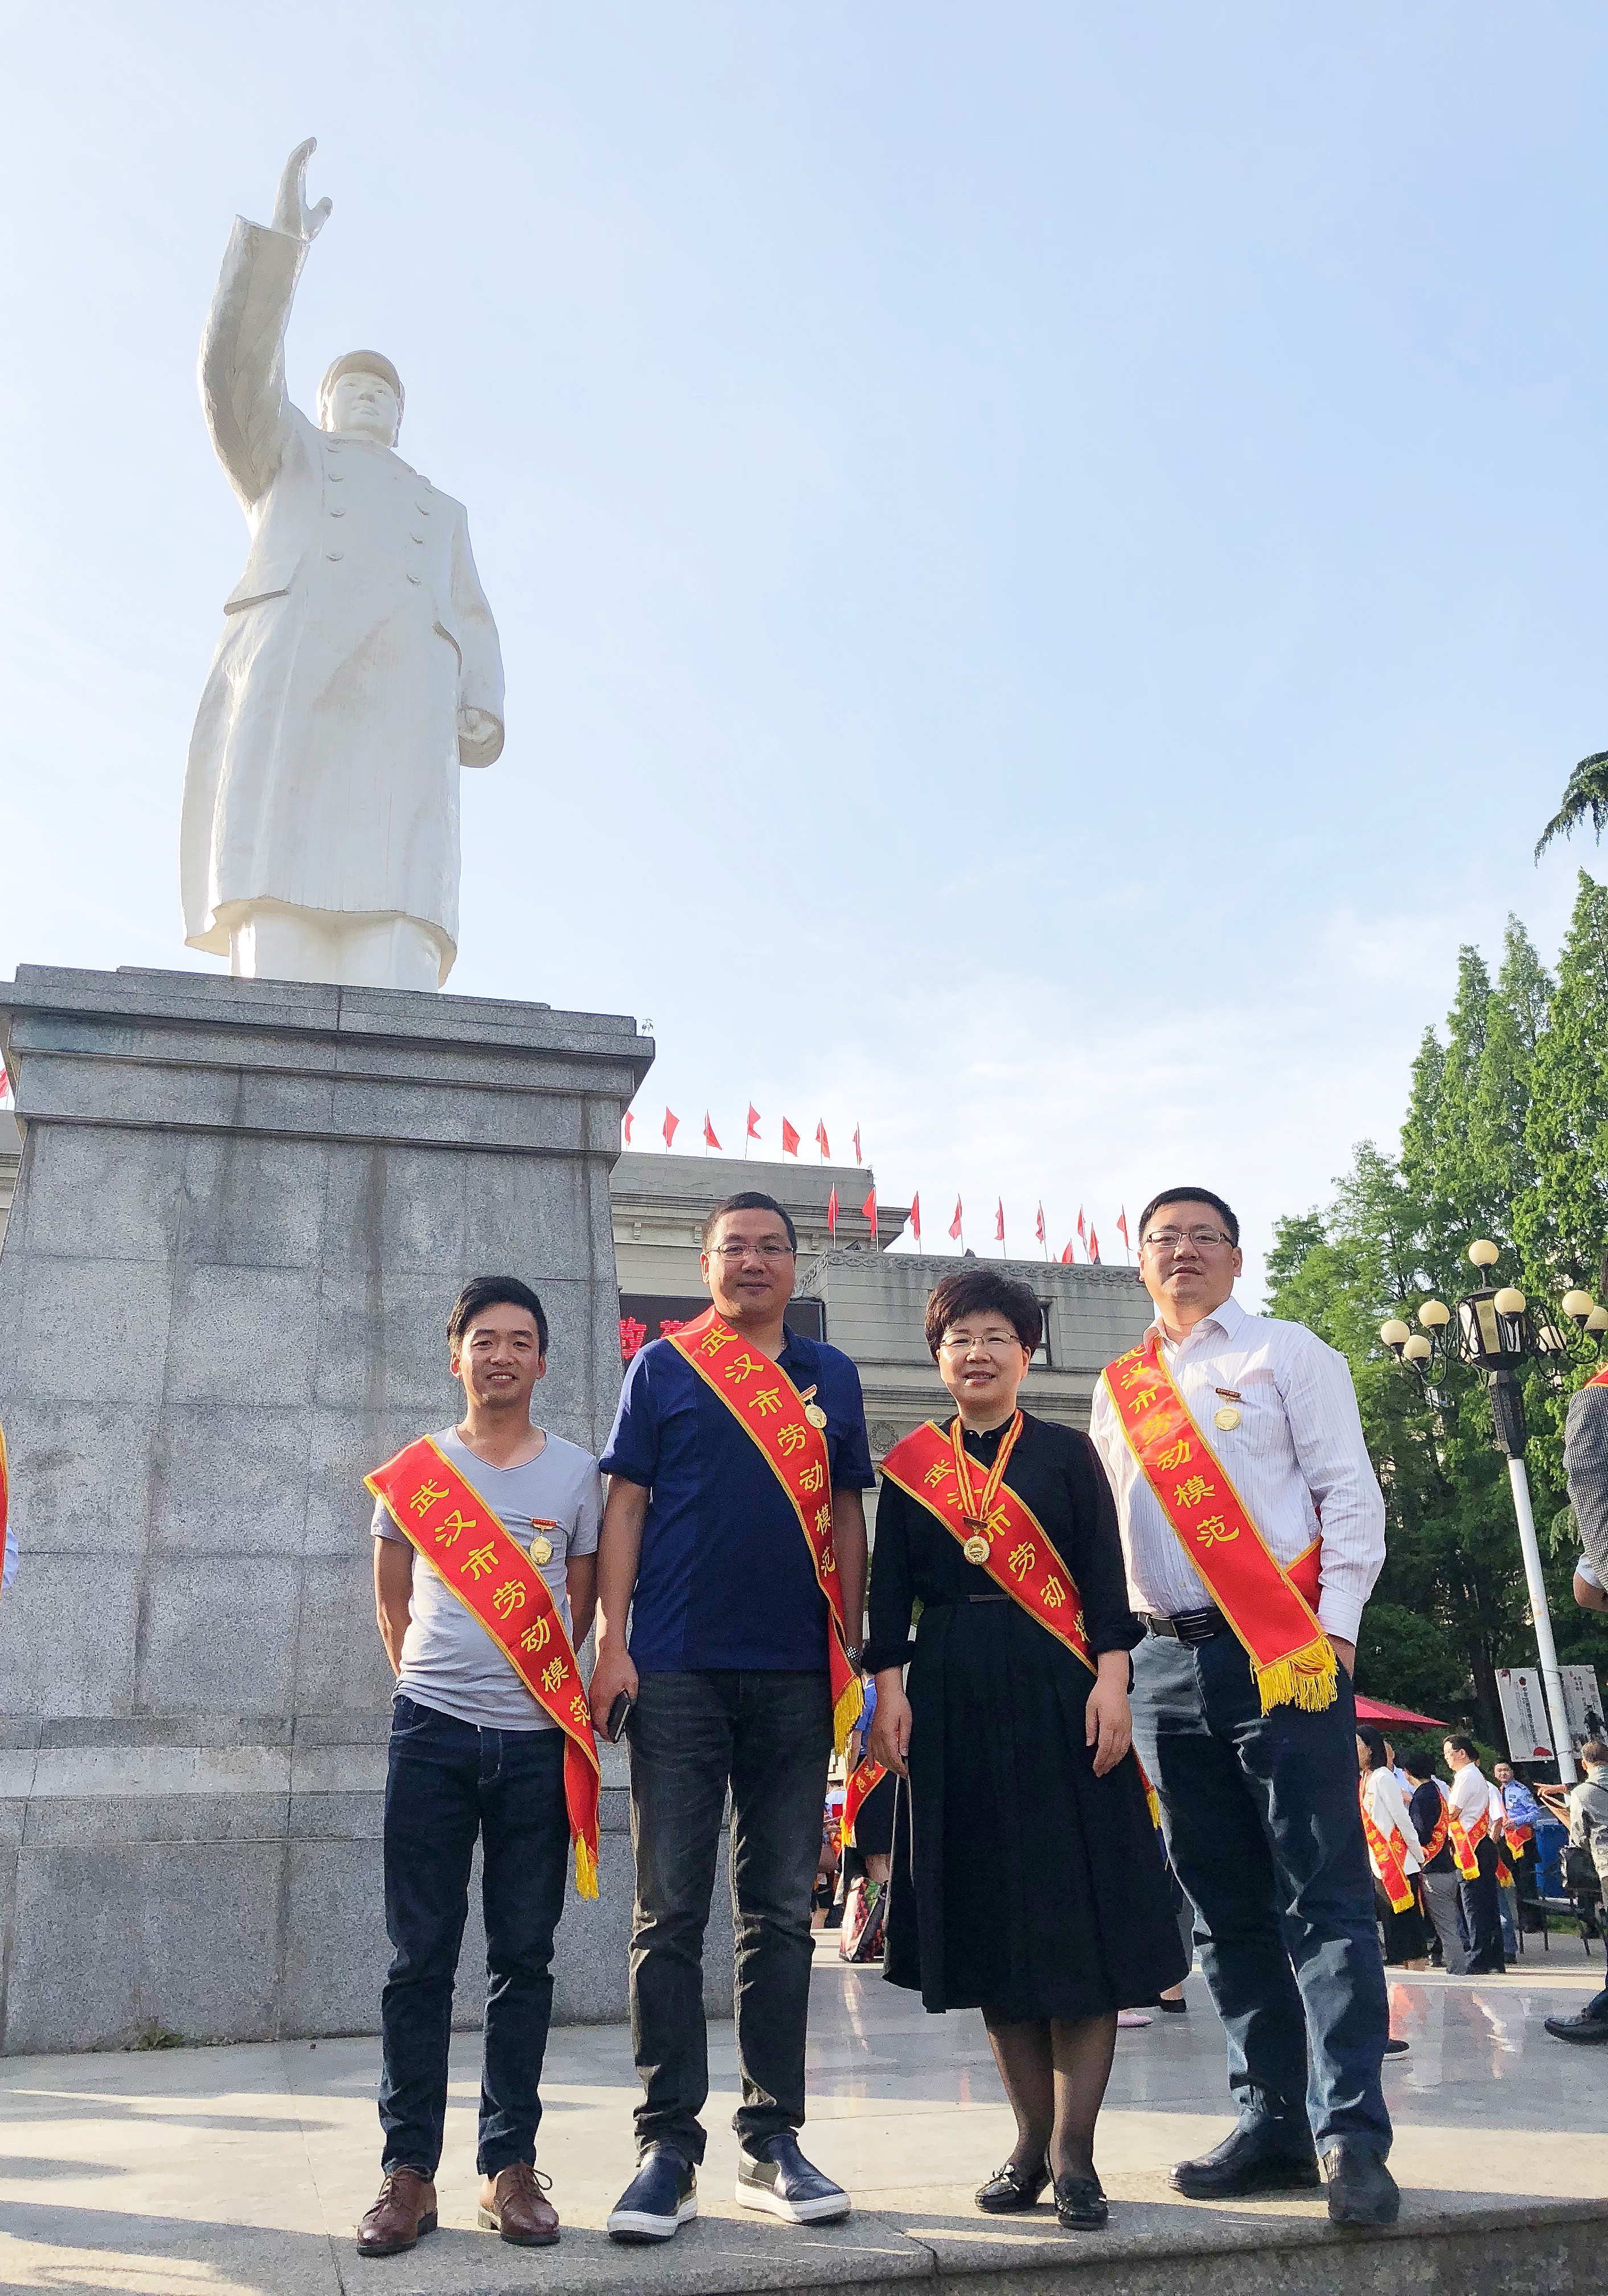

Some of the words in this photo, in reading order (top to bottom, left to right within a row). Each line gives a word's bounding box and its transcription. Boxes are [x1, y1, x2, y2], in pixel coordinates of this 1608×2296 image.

[701, 1324, 835, 1577] 武汉市劳动模范
[1115, 1346, 1238, 1548] 武汉市劳动模范
[410, 1479, 590, 1727] 武汉市劳动模范
